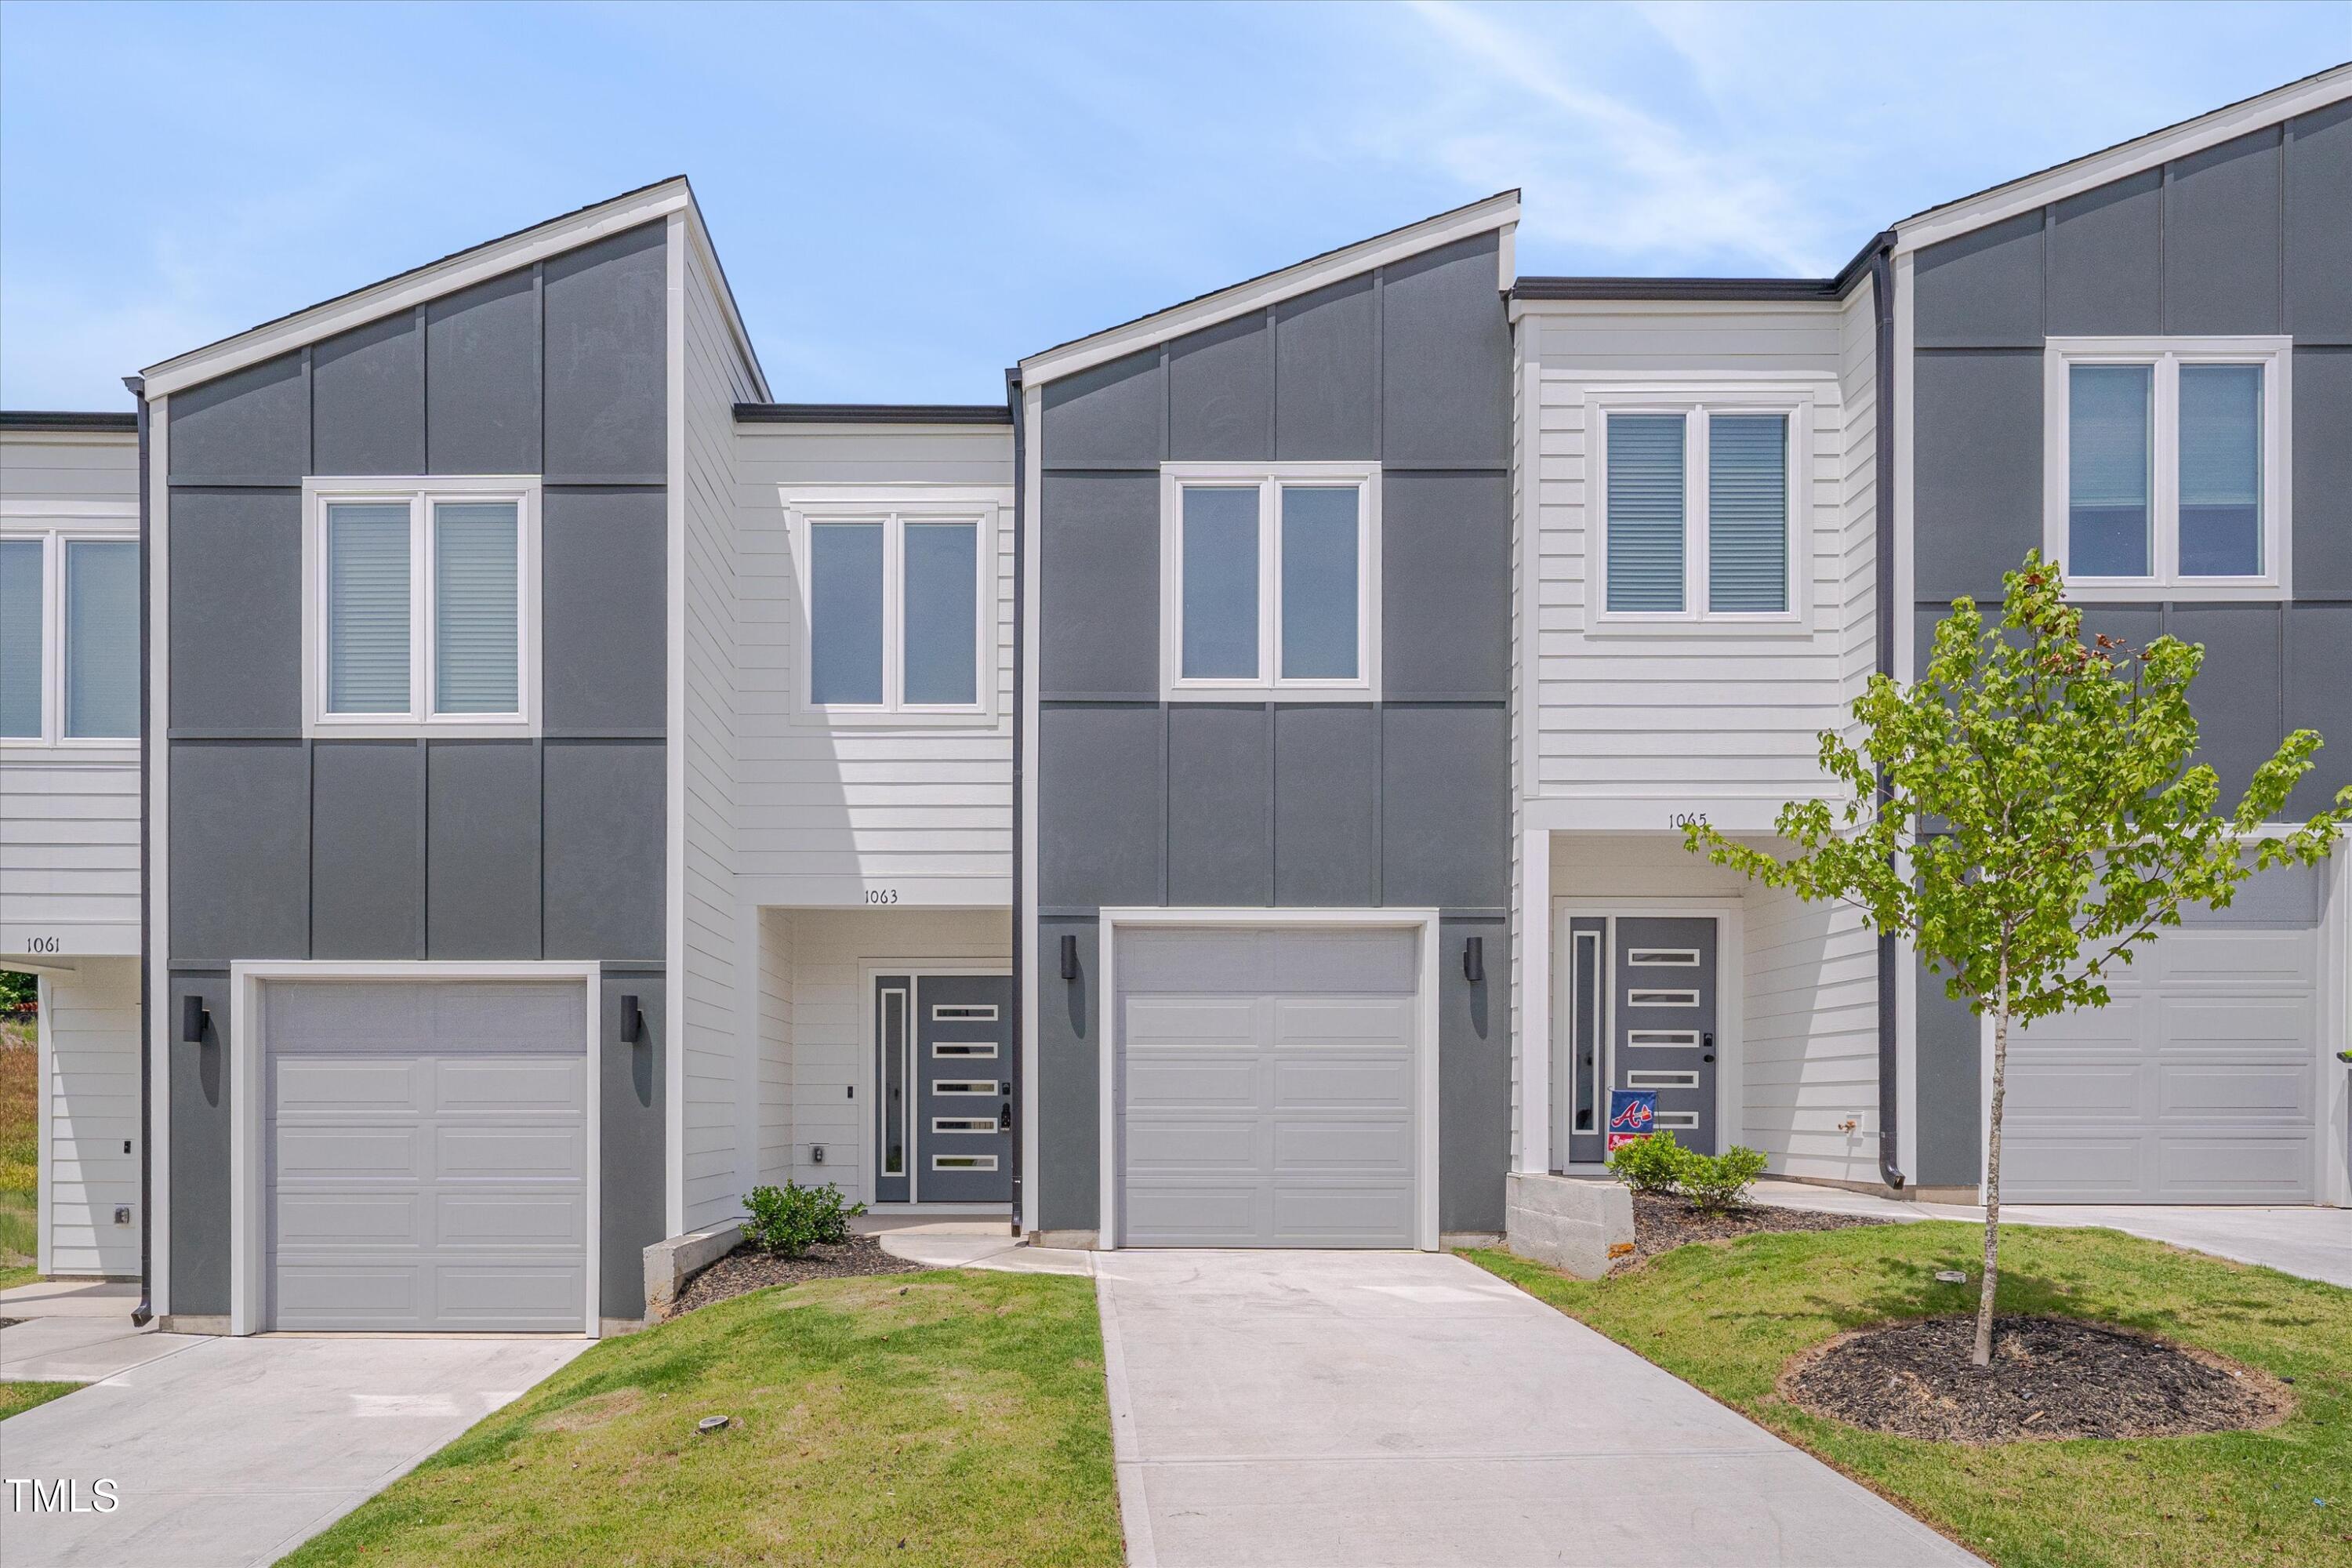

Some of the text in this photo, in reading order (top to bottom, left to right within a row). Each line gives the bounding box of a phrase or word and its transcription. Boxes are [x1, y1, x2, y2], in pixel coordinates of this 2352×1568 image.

[1669, 812, 1707, 829] 1065
[865, 889, 898, 904] 1063
[27, 936, 59, 953] 1061
